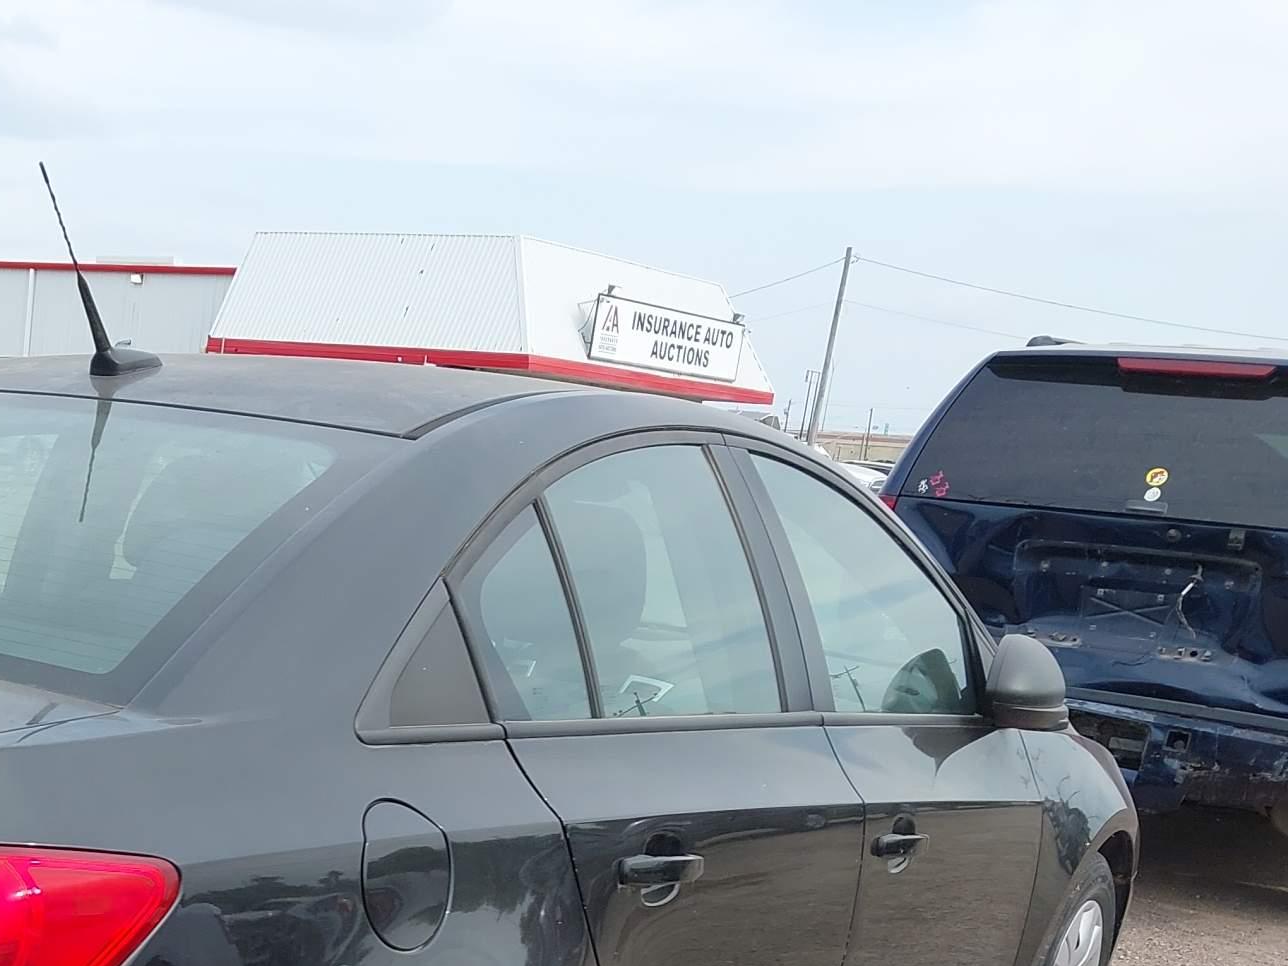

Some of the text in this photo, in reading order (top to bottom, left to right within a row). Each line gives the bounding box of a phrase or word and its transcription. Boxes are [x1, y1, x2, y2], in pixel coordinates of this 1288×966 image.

[632, 311, 734, 349] INSURANCE AUTO
[650, 340, 710, 368] AUCTIONS
